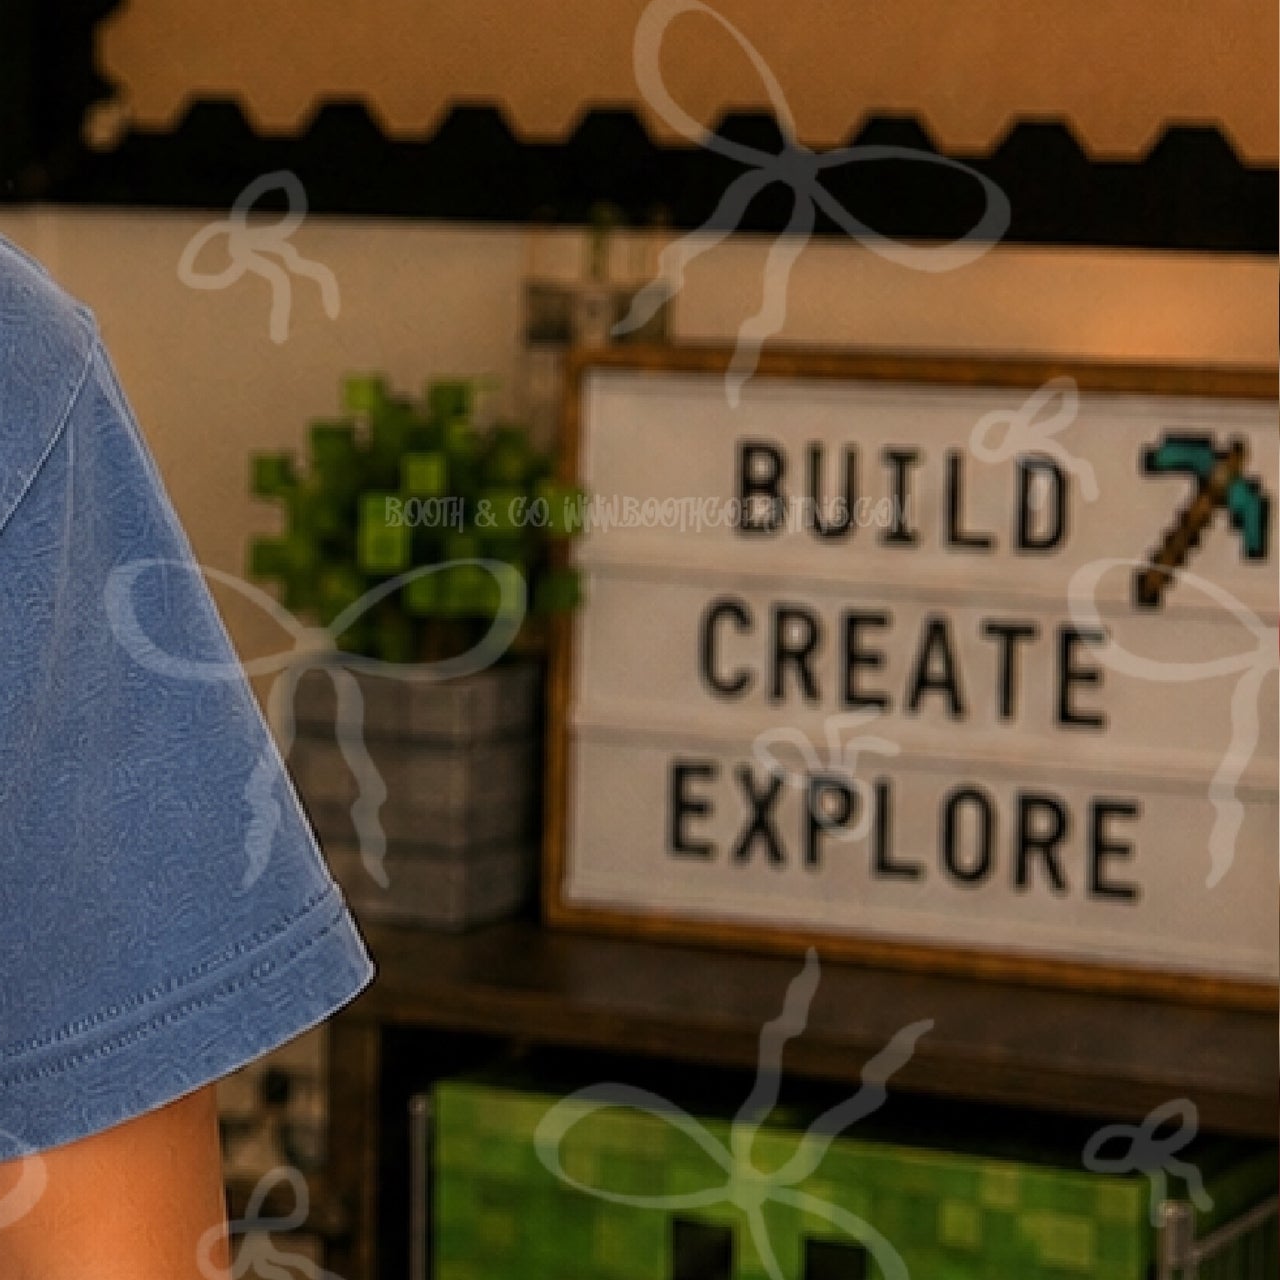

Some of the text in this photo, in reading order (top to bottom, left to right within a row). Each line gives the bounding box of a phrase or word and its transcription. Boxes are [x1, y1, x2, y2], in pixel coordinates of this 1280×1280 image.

[737, 440, 1068, 553] BUILD
[699, 599, 1108, 729] CREATE
[669, 760, 1139, 901] EXPLORE
